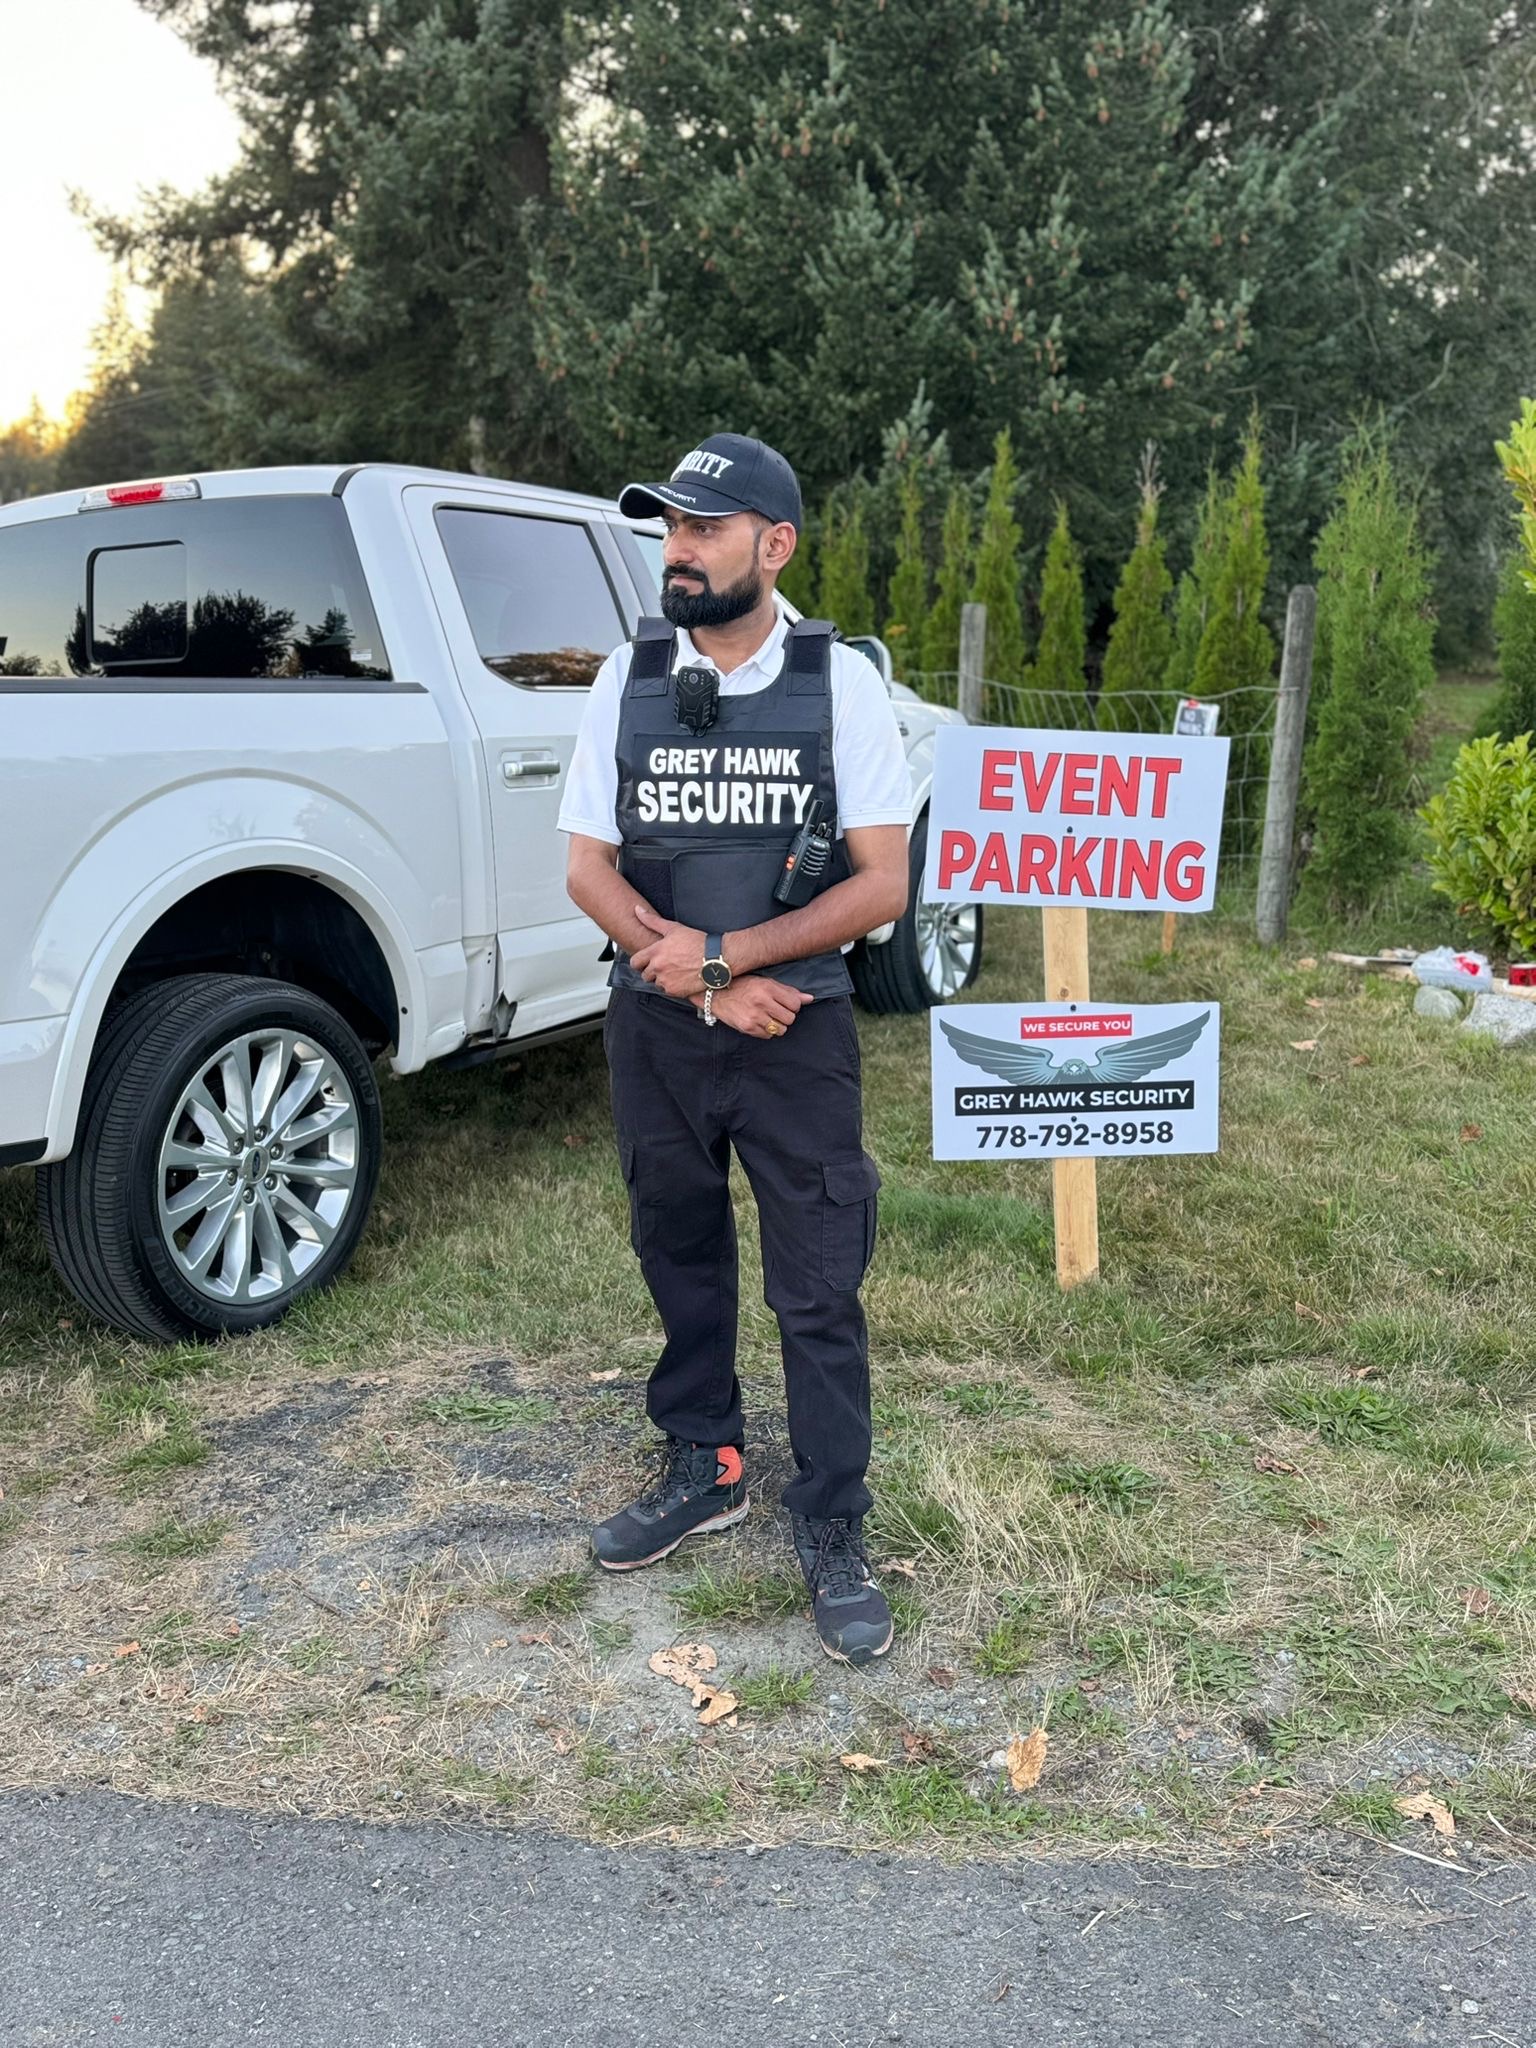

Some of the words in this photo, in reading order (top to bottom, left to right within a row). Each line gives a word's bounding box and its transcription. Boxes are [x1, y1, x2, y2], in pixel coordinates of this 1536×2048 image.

[671, 450, 734, 479] RITY
[649, 748, 717, 774] GREY
[724, 748, 801, 776] HAWK
[979, 749, 1182, 818] EVENT
[637, 781, 814, 824] SECURITY
[938, 830, 1206, 902] PARKING
[1023, 1023, 1046, 1033] WE
[1048, 1020, 1100, 1032] SECURE
[1103, 1019, 1131, 1031] YOU
[959, 1093, 1014, 1110] GREY
[1020, 1090, 1086, 1109] HAWK
[1089, 1087, 1190, 1106] SECURITY
[976, 1121, 1174, 1148] 778-792-8958
